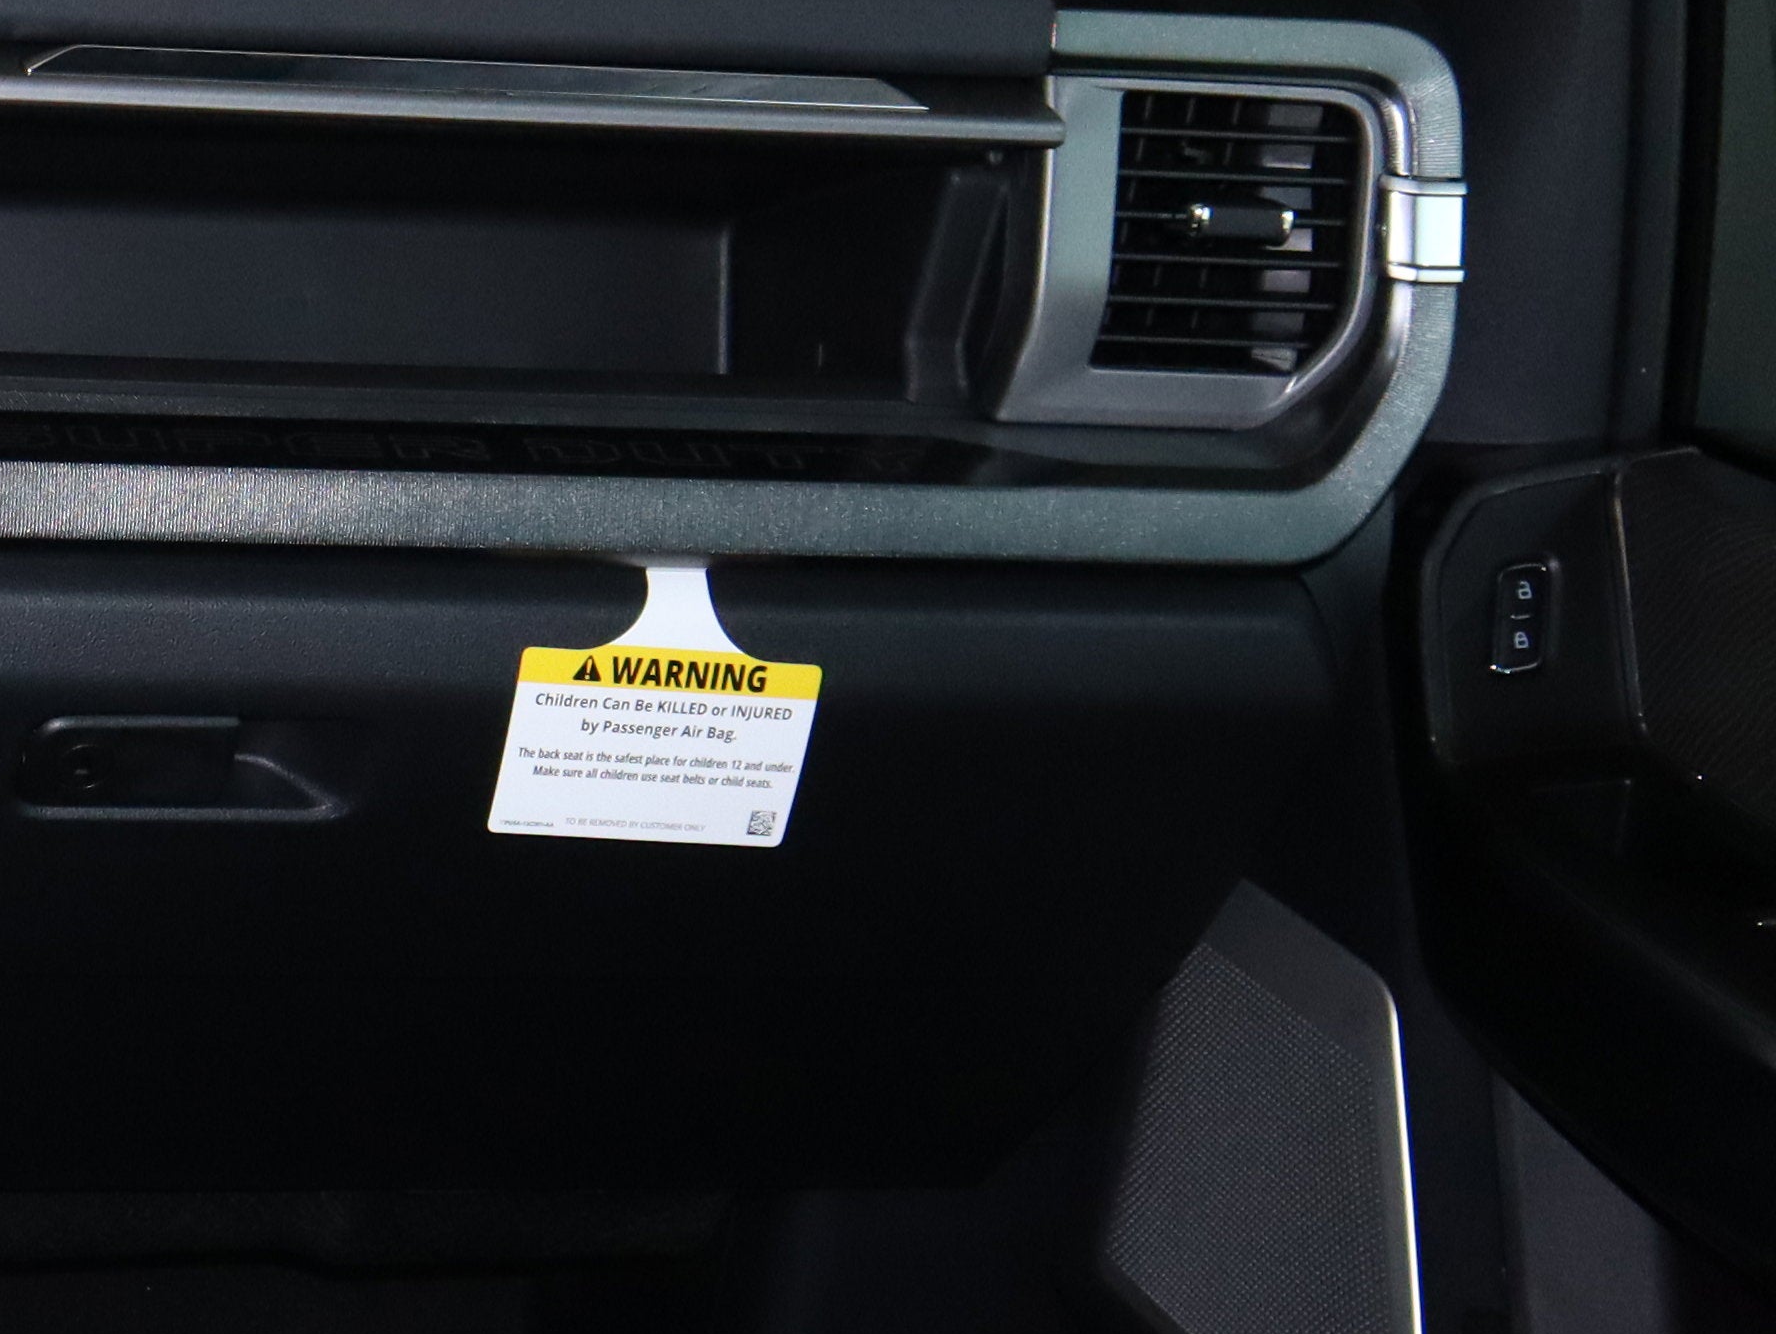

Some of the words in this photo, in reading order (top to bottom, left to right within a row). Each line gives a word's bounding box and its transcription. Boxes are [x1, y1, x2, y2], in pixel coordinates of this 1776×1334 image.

[611, 655, 769, 693] WARNING
[535, 692, 598, 709] Children
[602, 696, 631, 712] Can
[635, 699, 653, 713] Be
[657, 700, 708, 716] KILLED
[711, 705, 728, 717] or
[730, 705, 793, 722] INJURED
[581, 718, 599, 735] by
[602, 720, 678, 739] Passenger
[681, 725, 703, 739] Air
[707, 727, 737, 744] Bag.
[518, 747, 536, 758] The
[538, 748, 561, 760] back
[563, 750, 584, 761] seat
[586, 751, 594, 762] is
[596, 751, 613, 763] the
[614, 752, 643, 764] safest
[644, 754, 671, 767] place
[673, 755, 688, 767] for
[689, 756, 728, 769] children
[731, 760, 743, 770] 12
[744, 760, 763, 771] and
[533, 765, 560, 777] Make
[562, 768, 584, 778] sure
[586, 768, 599, 779] all
[600, 769, 639, 781] children
[641, 772, 657, 783] use
[659, 773, 681, 784] seat
[682, 773, 706, 785] belts
[708, 776, 720, 786] or
[721, 776, 745, 787] child
